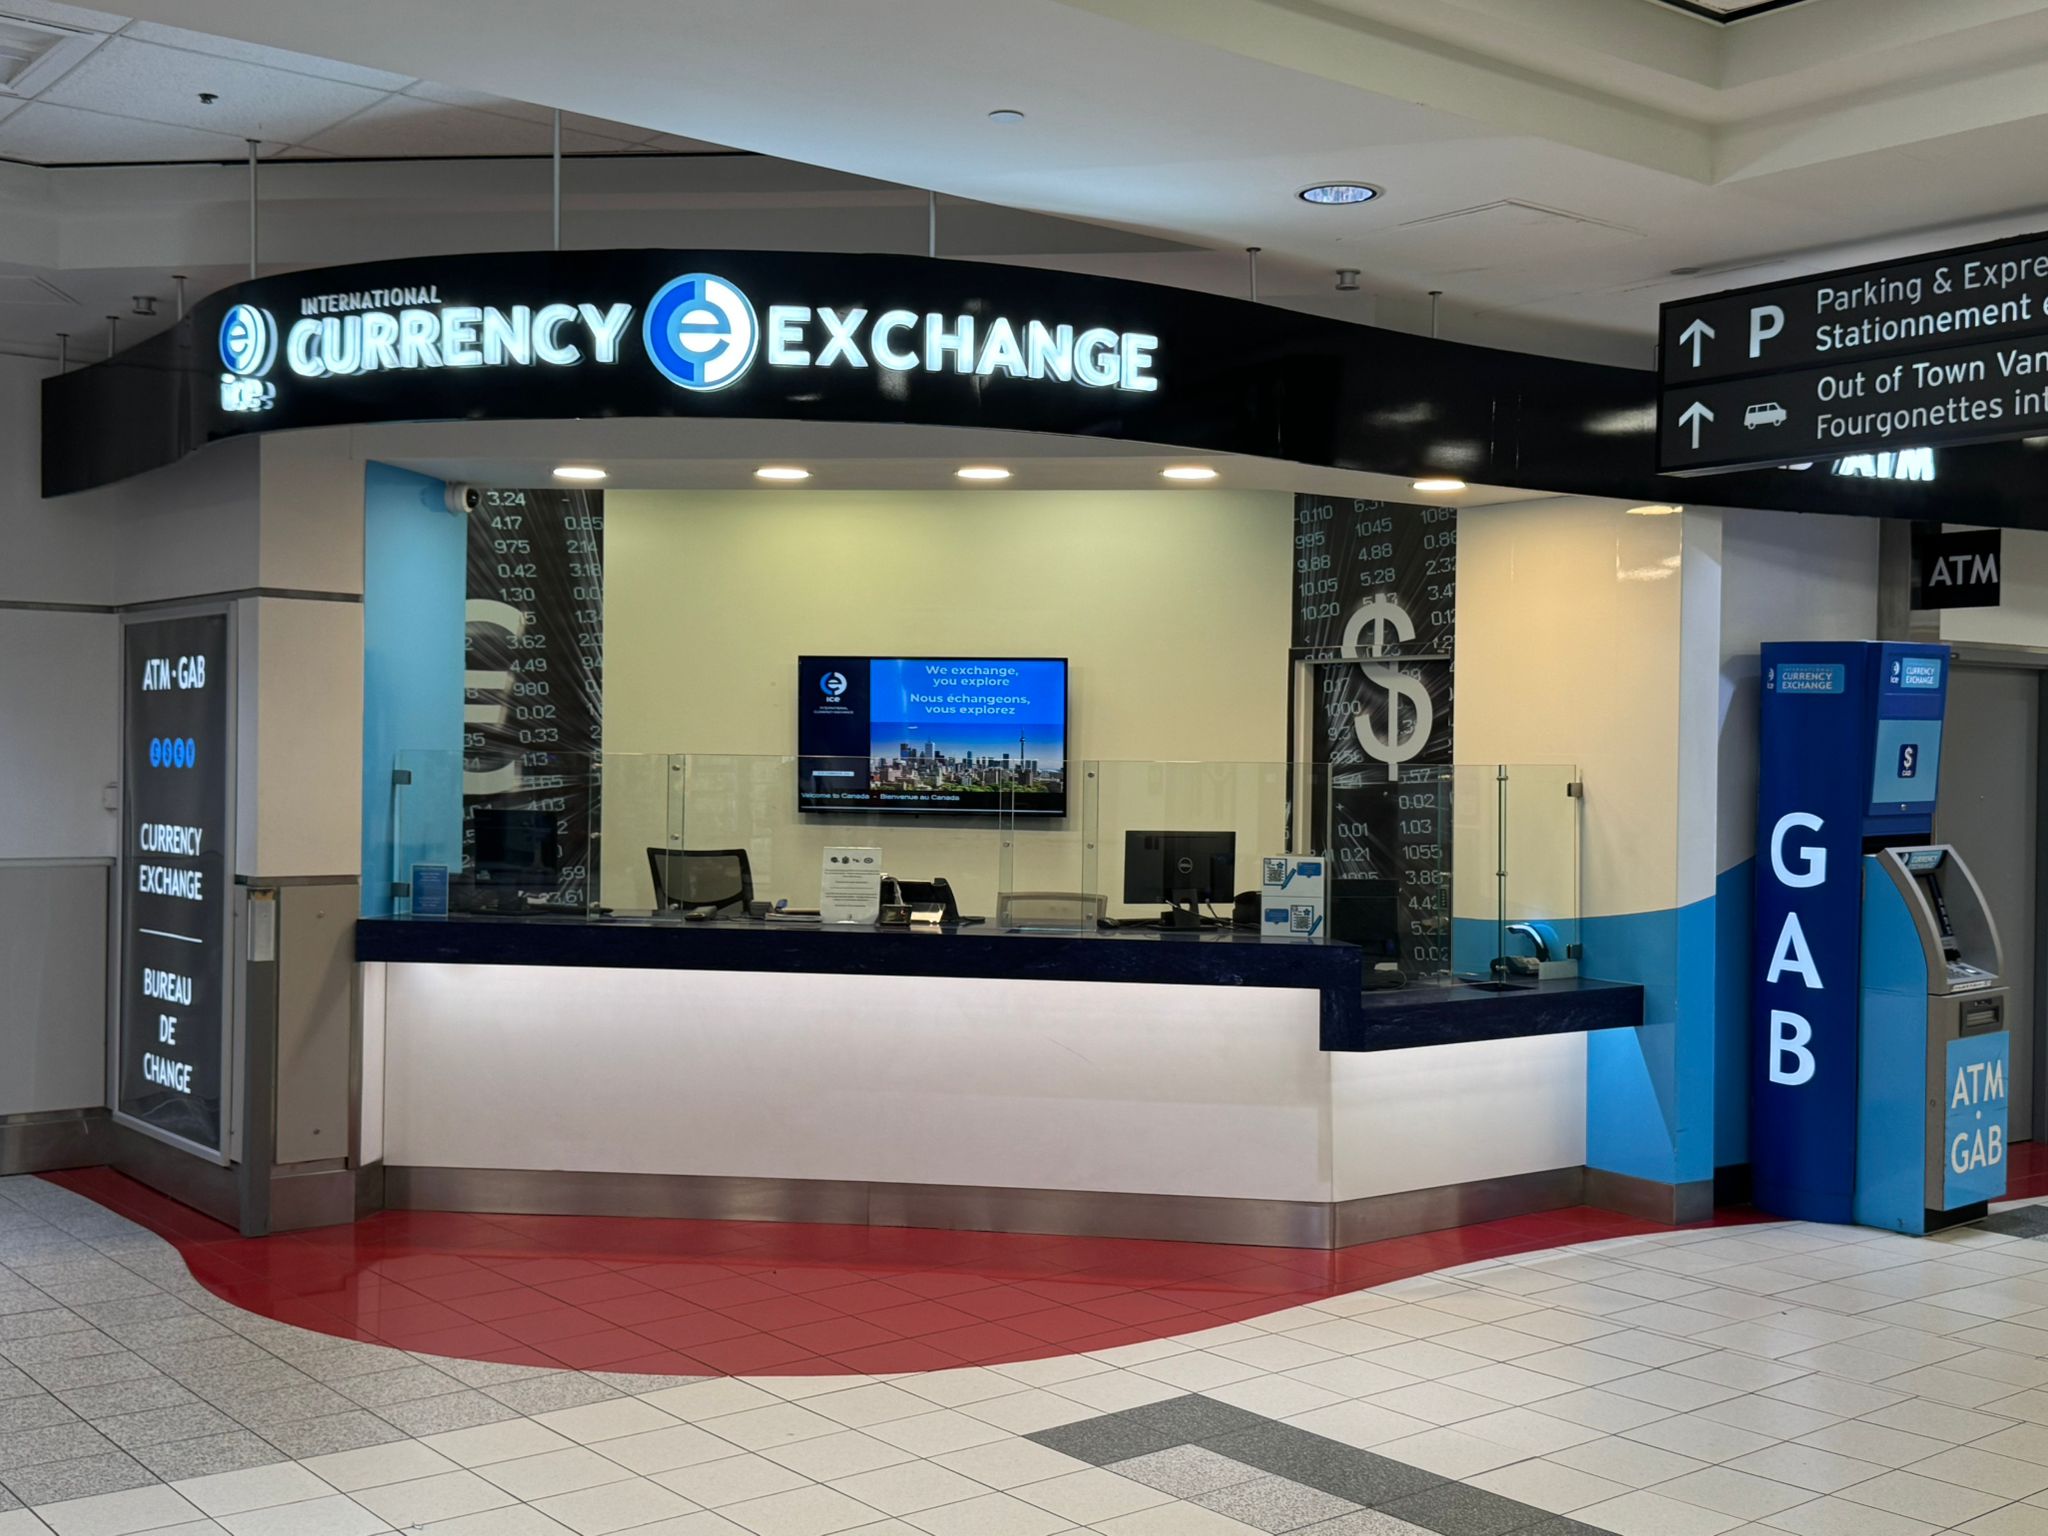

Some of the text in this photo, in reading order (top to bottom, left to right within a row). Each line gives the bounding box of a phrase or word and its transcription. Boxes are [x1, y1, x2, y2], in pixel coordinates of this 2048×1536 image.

[1816, 277, 1922, 314] Parking
[1933, 266, 1953, 293] &
[301, 284, 441, 315] INTERNATIONAL
[1816, 293, 2032, 351] Stationnement
[1749, 304, 1785, 358] P
[287, 303, 636, 378] CURRENCY
[767, 305, 1159, 392] EXCHANGE
[1817, 372, 1866, 402] Out
[1875, 365, 1903, 394] of
[1911, 360, 1985, 390] Town
[1816, 395, 2003, 441] Fourgonettes
[487, 491, 526, 506] 3.24
[491, 516, 522, 530] 4.17
[1355, 518, 1392, 537] 1045
[494, 539, 530, 554] 975
[566, 540, 598, 554] 2.14
[1295, 531, 1325, 549] 995
[1358, 543, 1392, 562] 4.88
[497, 564, 537, 578] 0.42
[1360, 567, 1395, 586] 5.28
[1928, 553, 1999, 588] ATM
[499, 588, 535, 601] 1.30
[1299, 578, 1338, 597] 10.05
[1301, 602, 1340, 621] 10.20
[506, 635, 546, 649] 3.62
[510, 658, 547, 672] 4.49
[925, 665, 1019, 679] We exchange,
[1905, 666, 1935, 676] CURRENCY
[932, 676, 1010, 688] you explore
[1782, 672, 1833, 681] CURRENCY
[1905, 676, 1934, 685] EXCHANGE
[513, 681, 549, 696] 980
[1782, 681, 1833, 690] EXCHANGE
[910, 692, 1031, 707] Nous échangeons,
[516, 705, 557, 720] 0.02
[925, 704, 1016, 717] vous explorez
[519, 728, 558, 743] 0.33
[1399, 794, 1435, 810] 0.02
[1338, 822, 1369, 838] 0.01
[1399, 819, 1432, 835] 1.03
[140, 822, 202, 857] CURRENCY
[1340, 846, 1371, 862] 0.21
[1402, 844, 1443, 861] 1055
[139, 864, 203, 902] EXCHANGE
[143, 967, 192, 1007] BUREAU
[159, 1013, 176, 1046] DE
[143, 1052, 193, 1095] CHANGE
[1951, 1059, 2004, 1109] ATM
[1950, 1125, 2003, 1174] GAB
